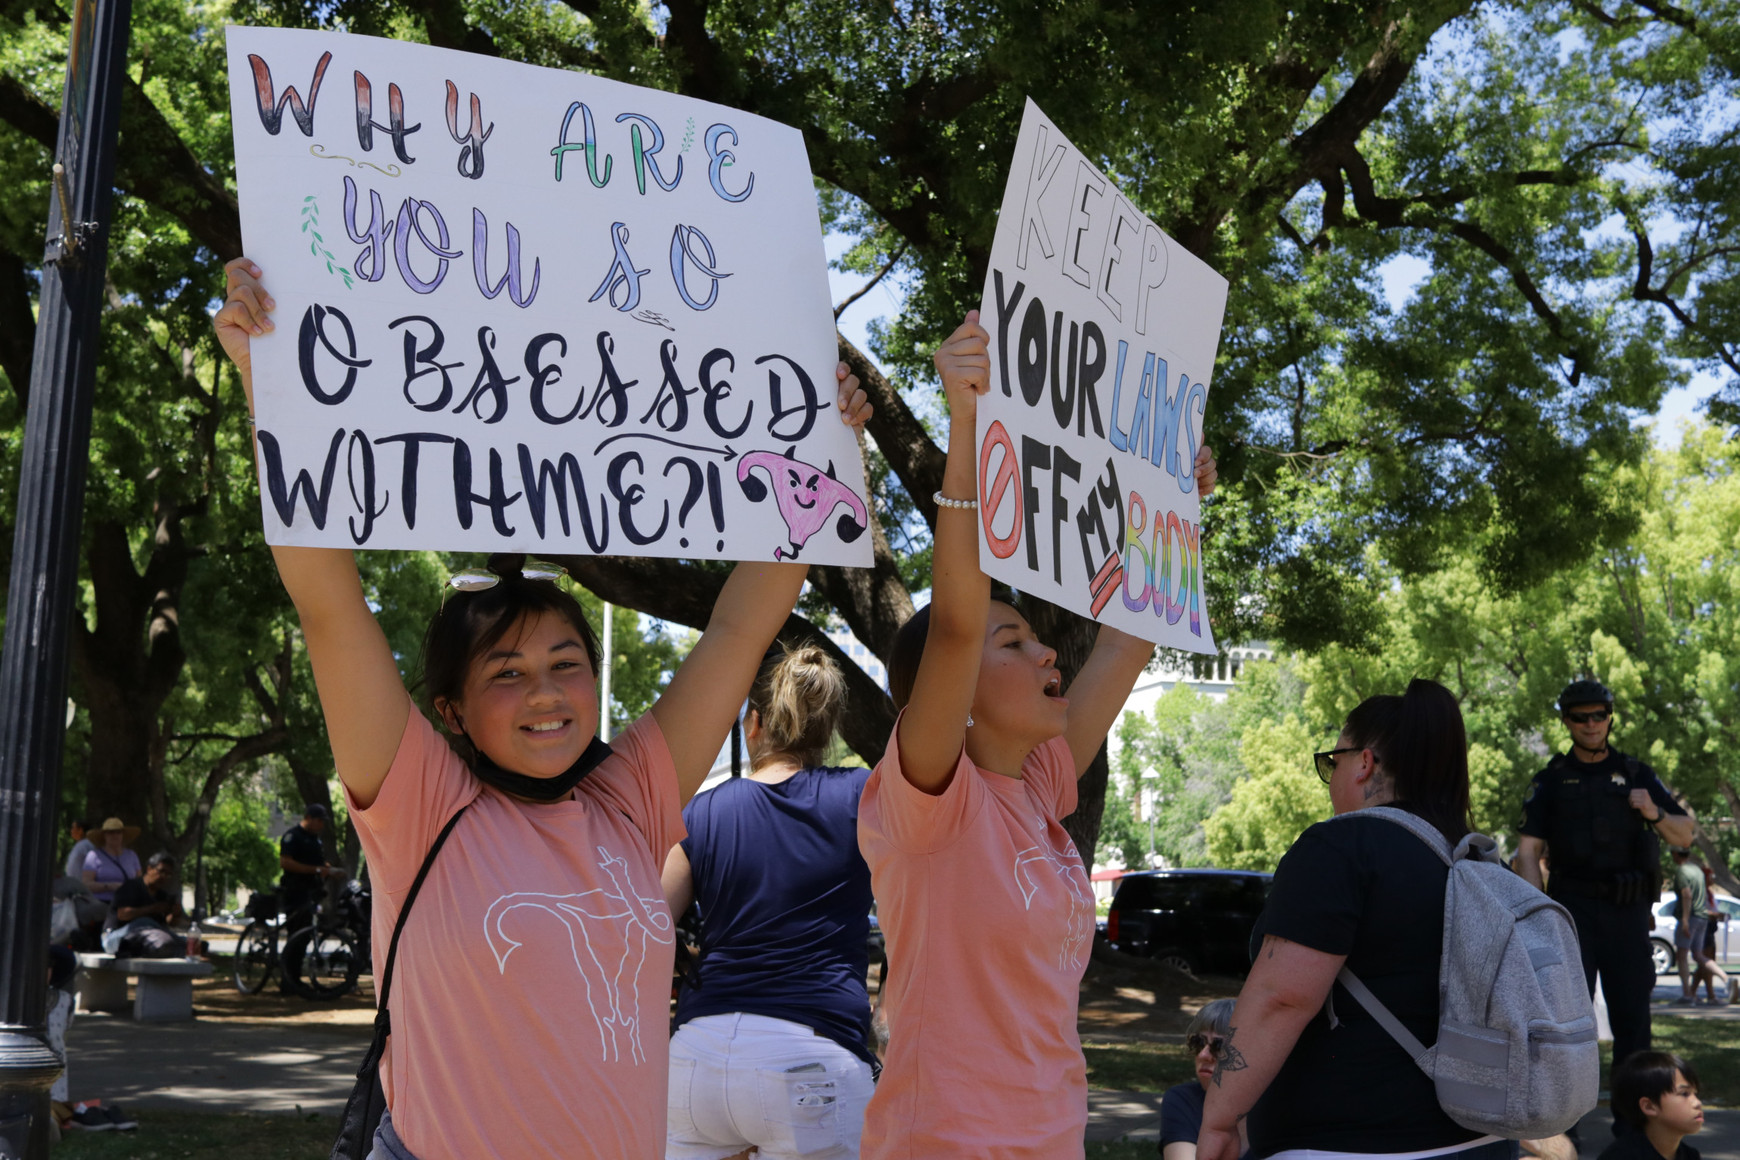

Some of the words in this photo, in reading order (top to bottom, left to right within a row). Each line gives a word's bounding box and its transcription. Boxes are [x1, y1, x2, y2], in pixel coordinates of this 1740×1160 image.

[550, 101, 755, 202] ARE
[588, 222, 734, 311] SO
[1016, 124, 1168, 336] KEEP
[298, 303, 831, 441] OBSESSED
[993, 268, 1107, 440] YOUR
[1109, 339, 1206, 494] LAWS
[257, 428, 522, 545] WITH
[518, 443, 726, 554] ME?!
[979, 420, 1082, 587] OFF
[1122, 491, 1201, 638] BODY
